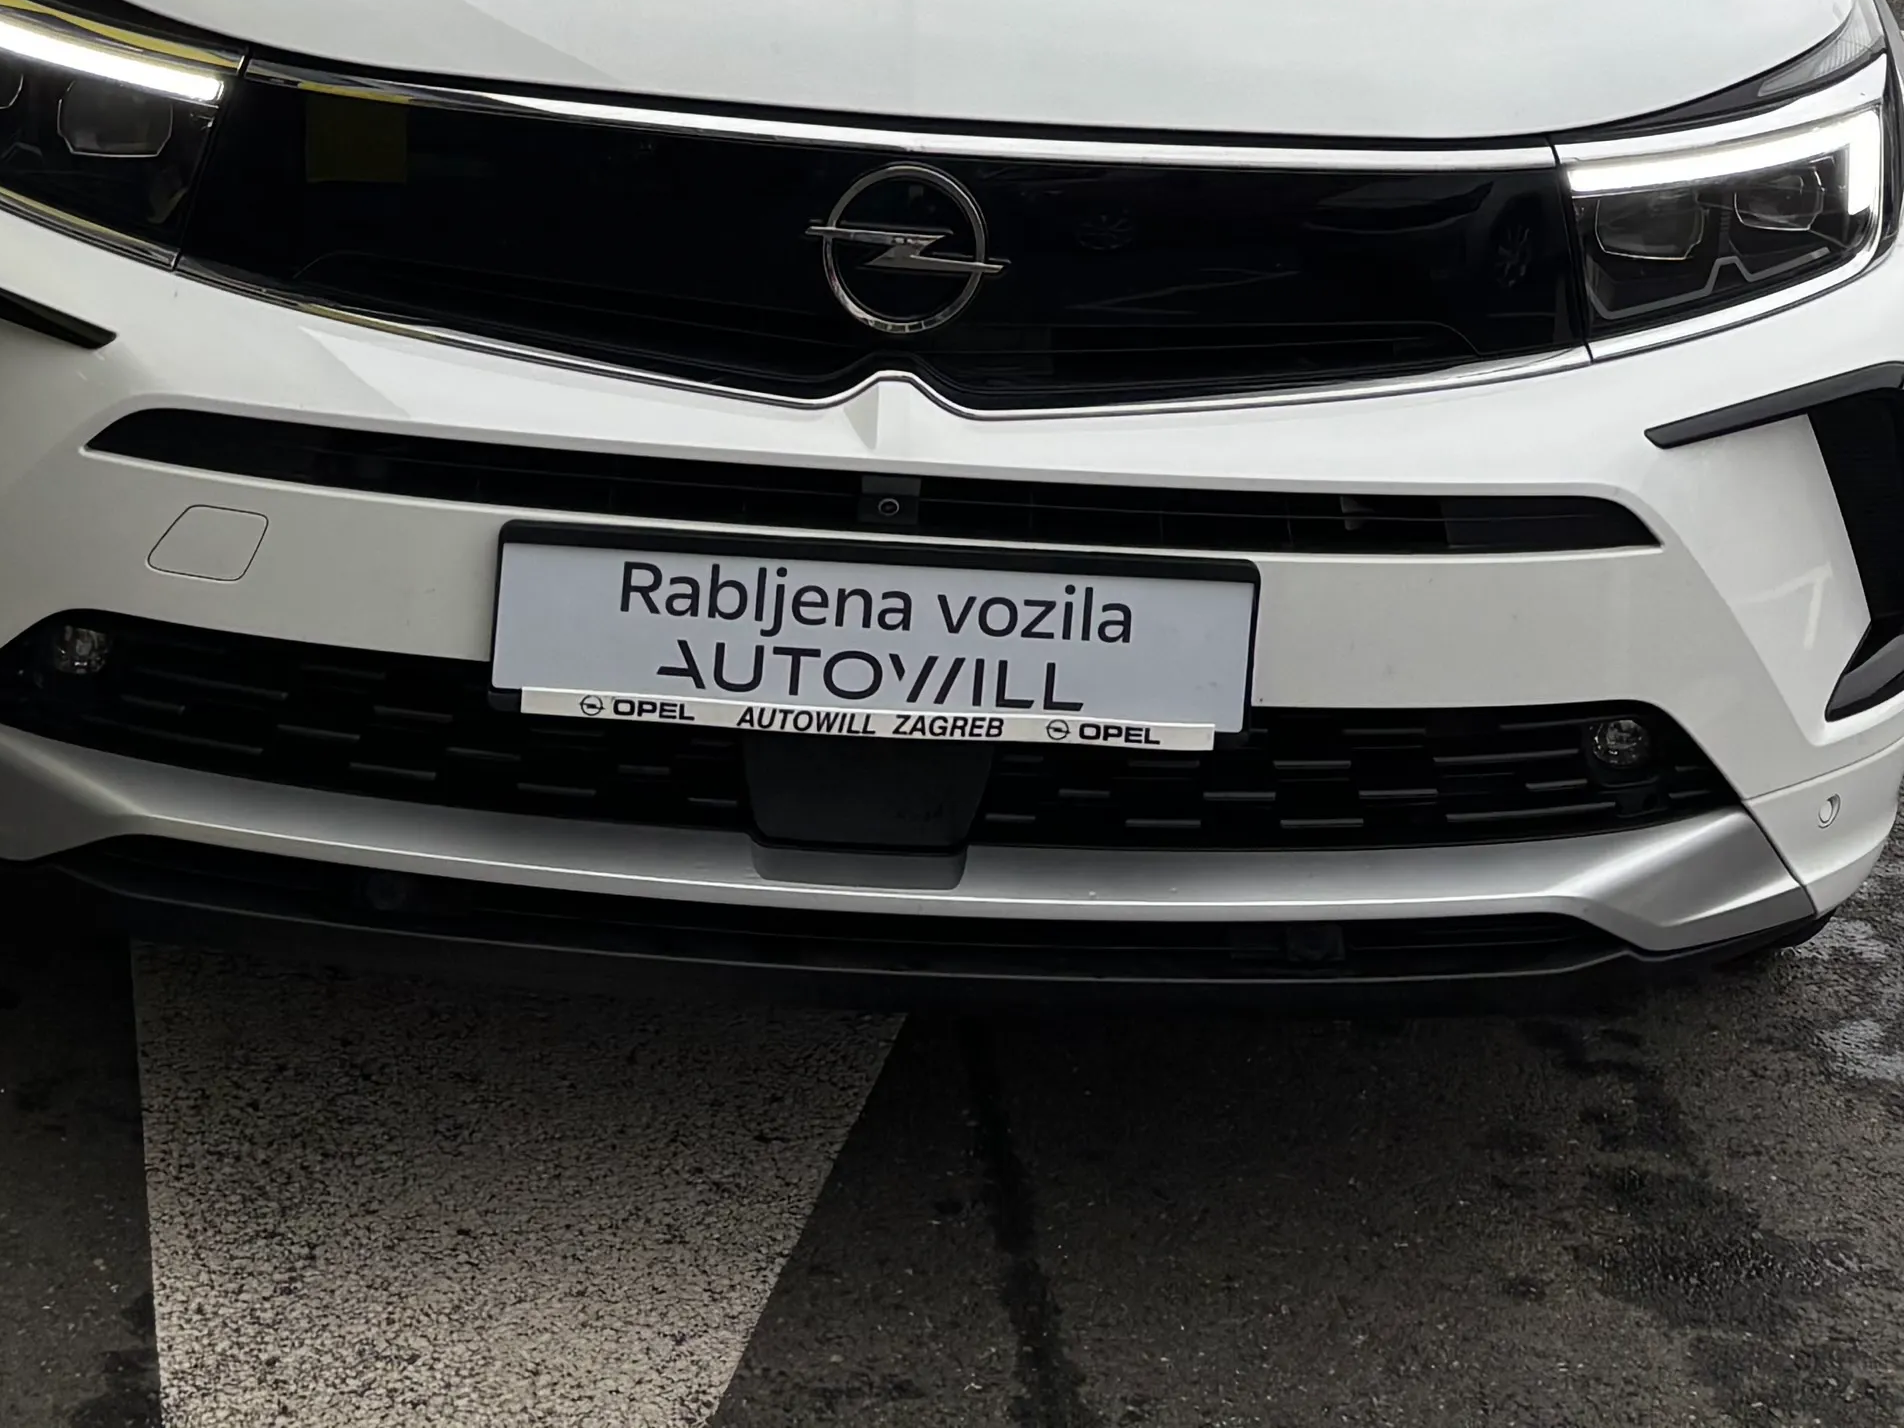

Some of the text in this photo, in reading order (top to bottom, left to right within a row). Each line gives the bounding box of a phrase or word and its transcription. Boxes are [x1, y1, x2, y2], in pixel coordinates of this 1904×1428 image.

[619, 561, 1133, 645] Rabljena vozila
[656, 639, 1084, 711] AUTOWILL
[612, 699, 1161, 745] OPEL AUTOWILL ZAGREB OPEL
